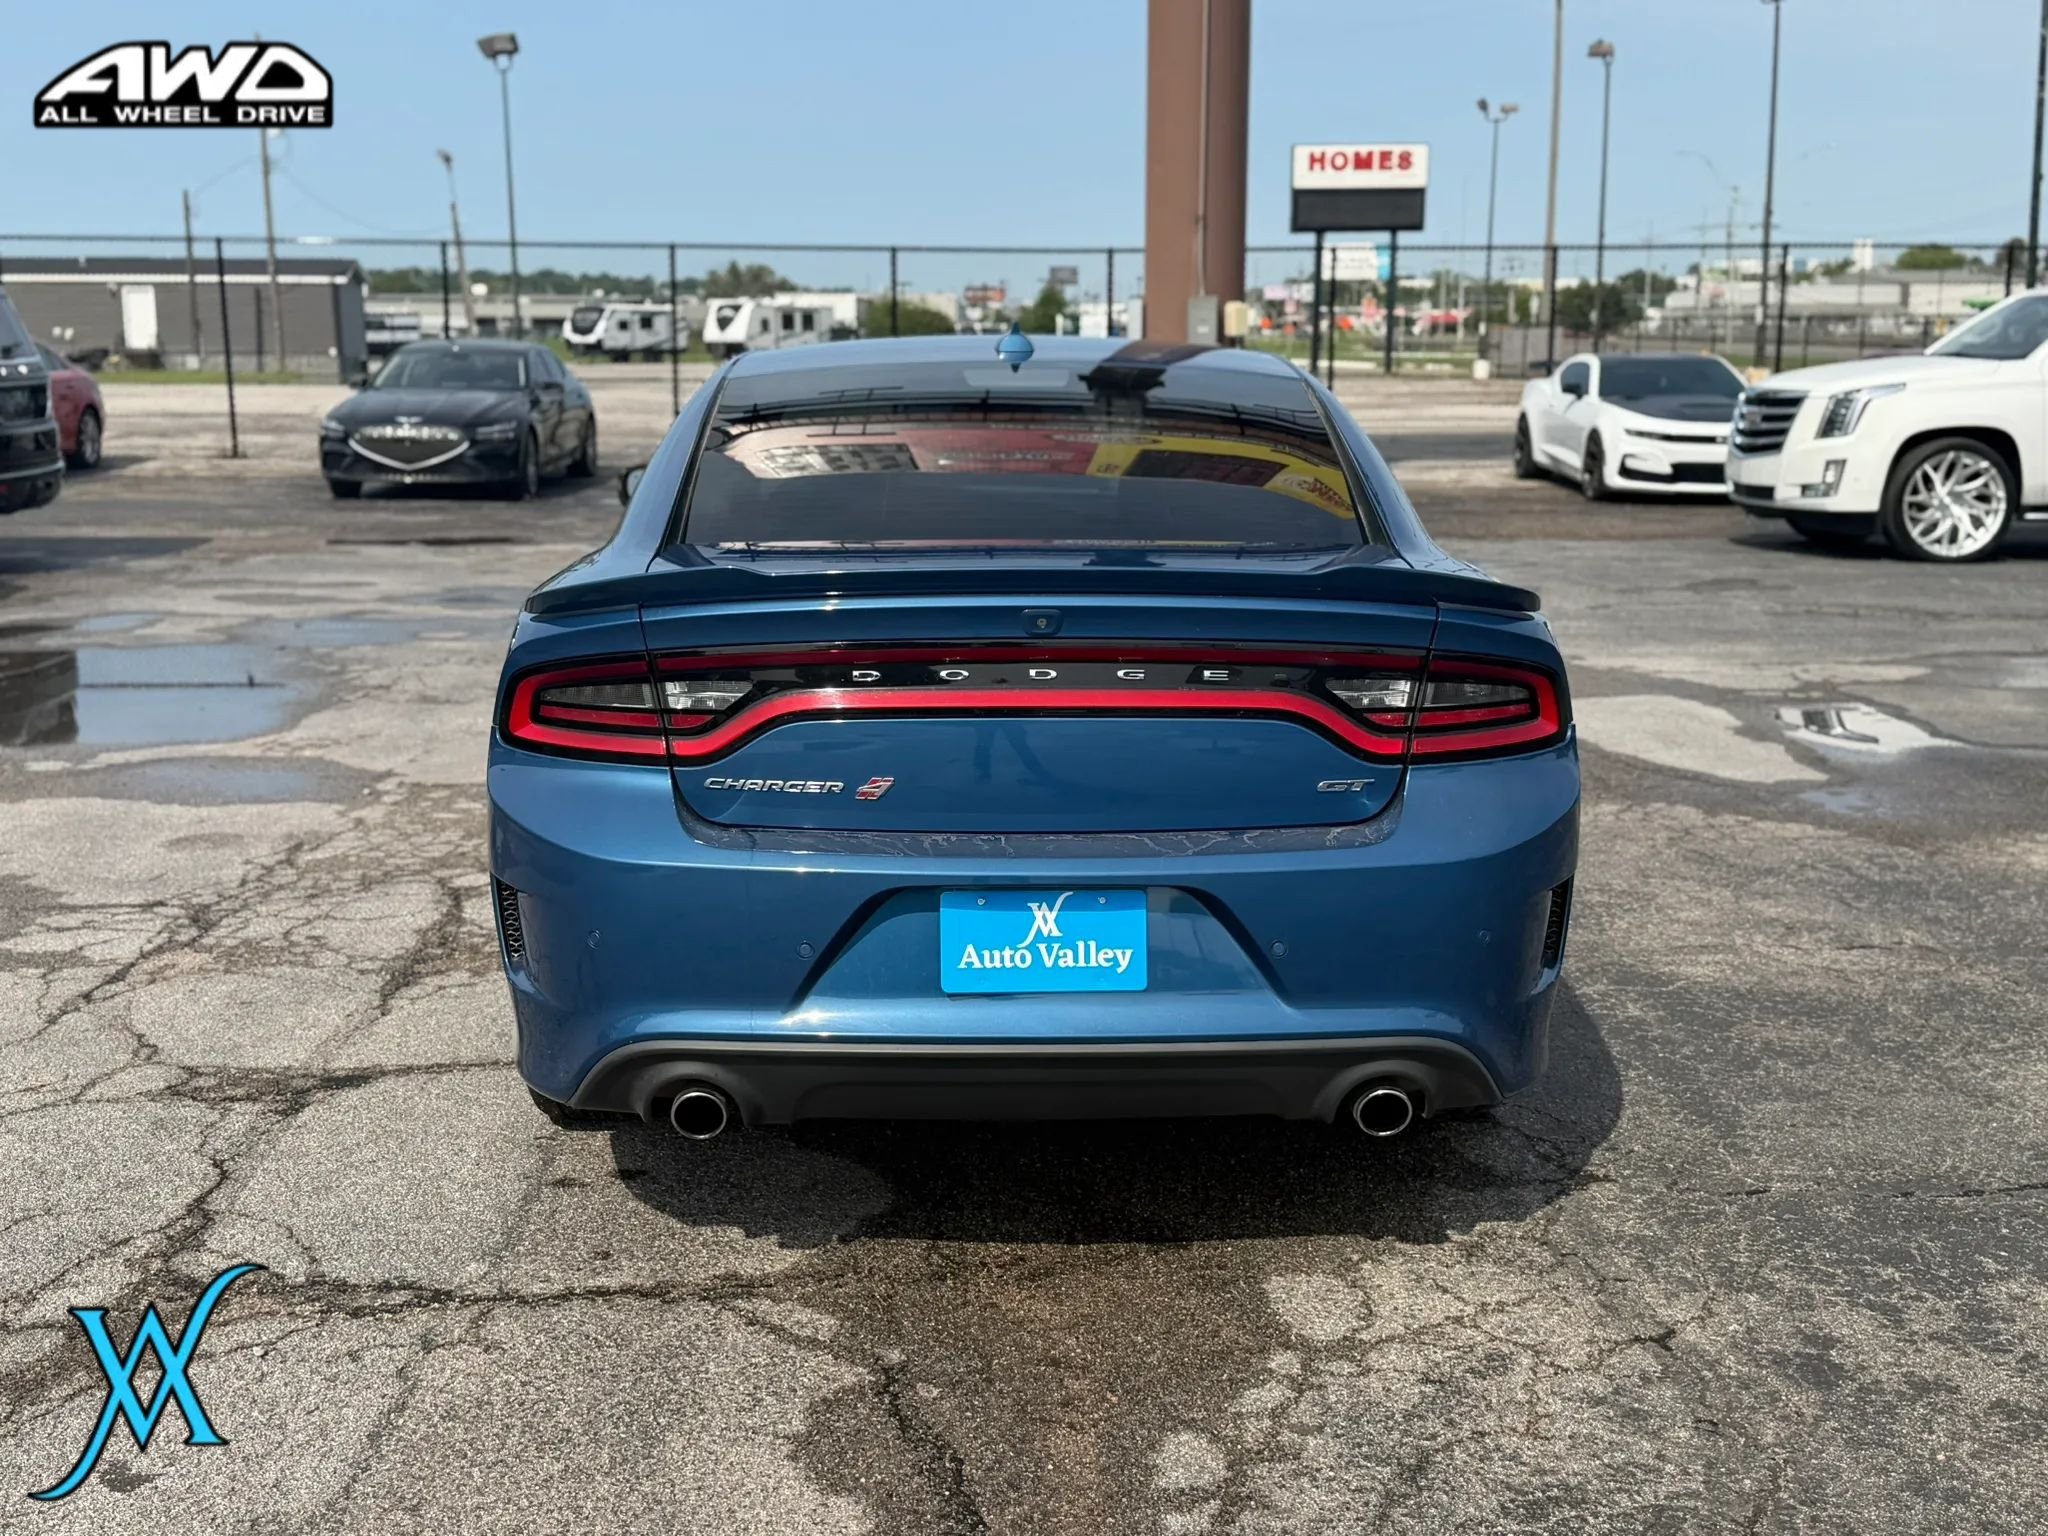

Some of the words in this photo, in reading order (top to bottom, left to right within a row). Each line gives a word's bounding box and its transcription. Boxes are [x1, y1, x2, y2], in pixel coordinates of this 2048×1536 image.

[1308, 150, 1413, 171] HOMES
[852, 668, 1230, 682] DODGE
[703, 777, 845, 793] CHARGER
[1316, 778, 1375, 792] GT
[957, 943, 1033, 969] Auto
[1036, 940, 1134, 974] Valley
